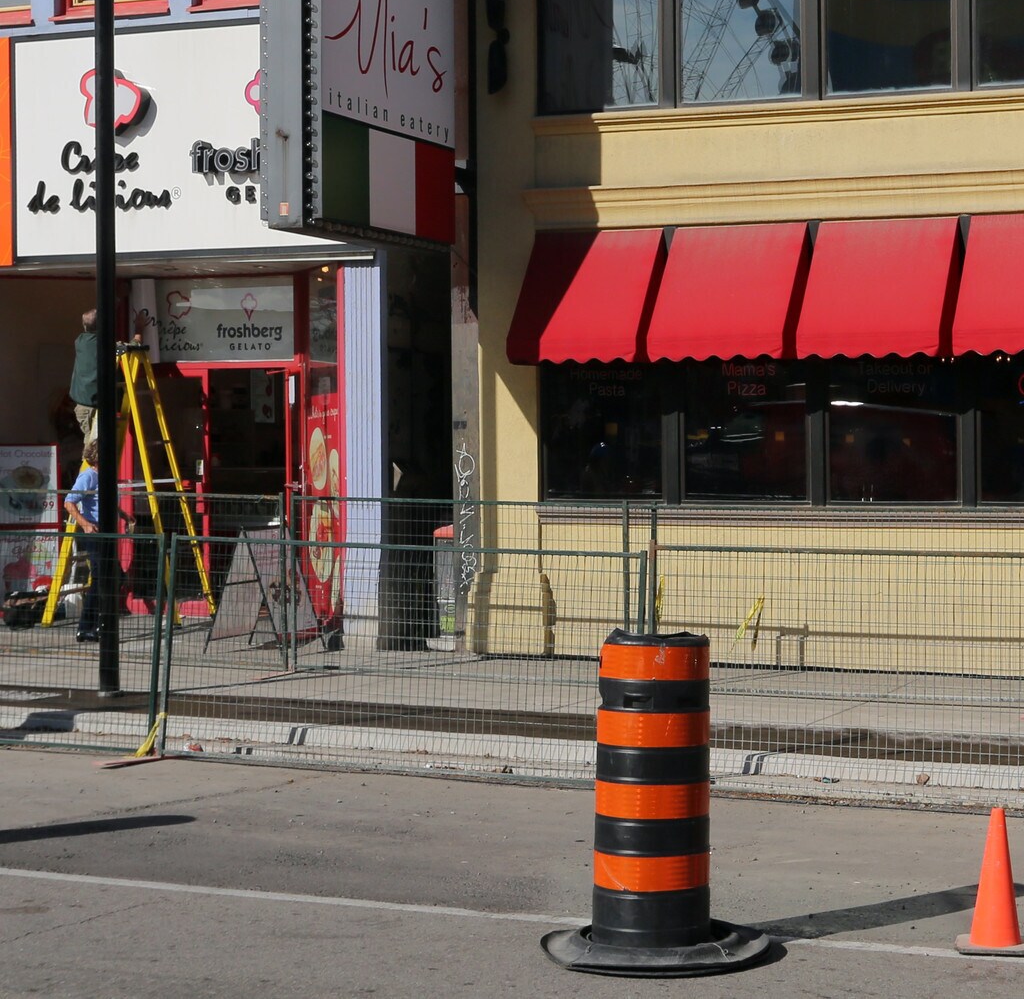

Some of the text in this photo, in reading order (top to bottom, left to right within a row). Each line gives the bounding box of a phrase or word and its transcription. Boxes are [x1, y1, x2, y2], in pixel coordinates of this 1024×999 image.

[328, 87, 450, 144] italian eatery
[216, 323, 283, 341] froshberg
[229, 342, 271, 351] GELATO
[570, 367, 642, 381] Homemade
[721, 361, 776, 377] Mama's
[858, 361, 933, 375] Takeout or
[588, 381, 625, 397] Pasta
[727, 380, 767, 396] Pizza
[867, 378, 926, 397] Delivery
